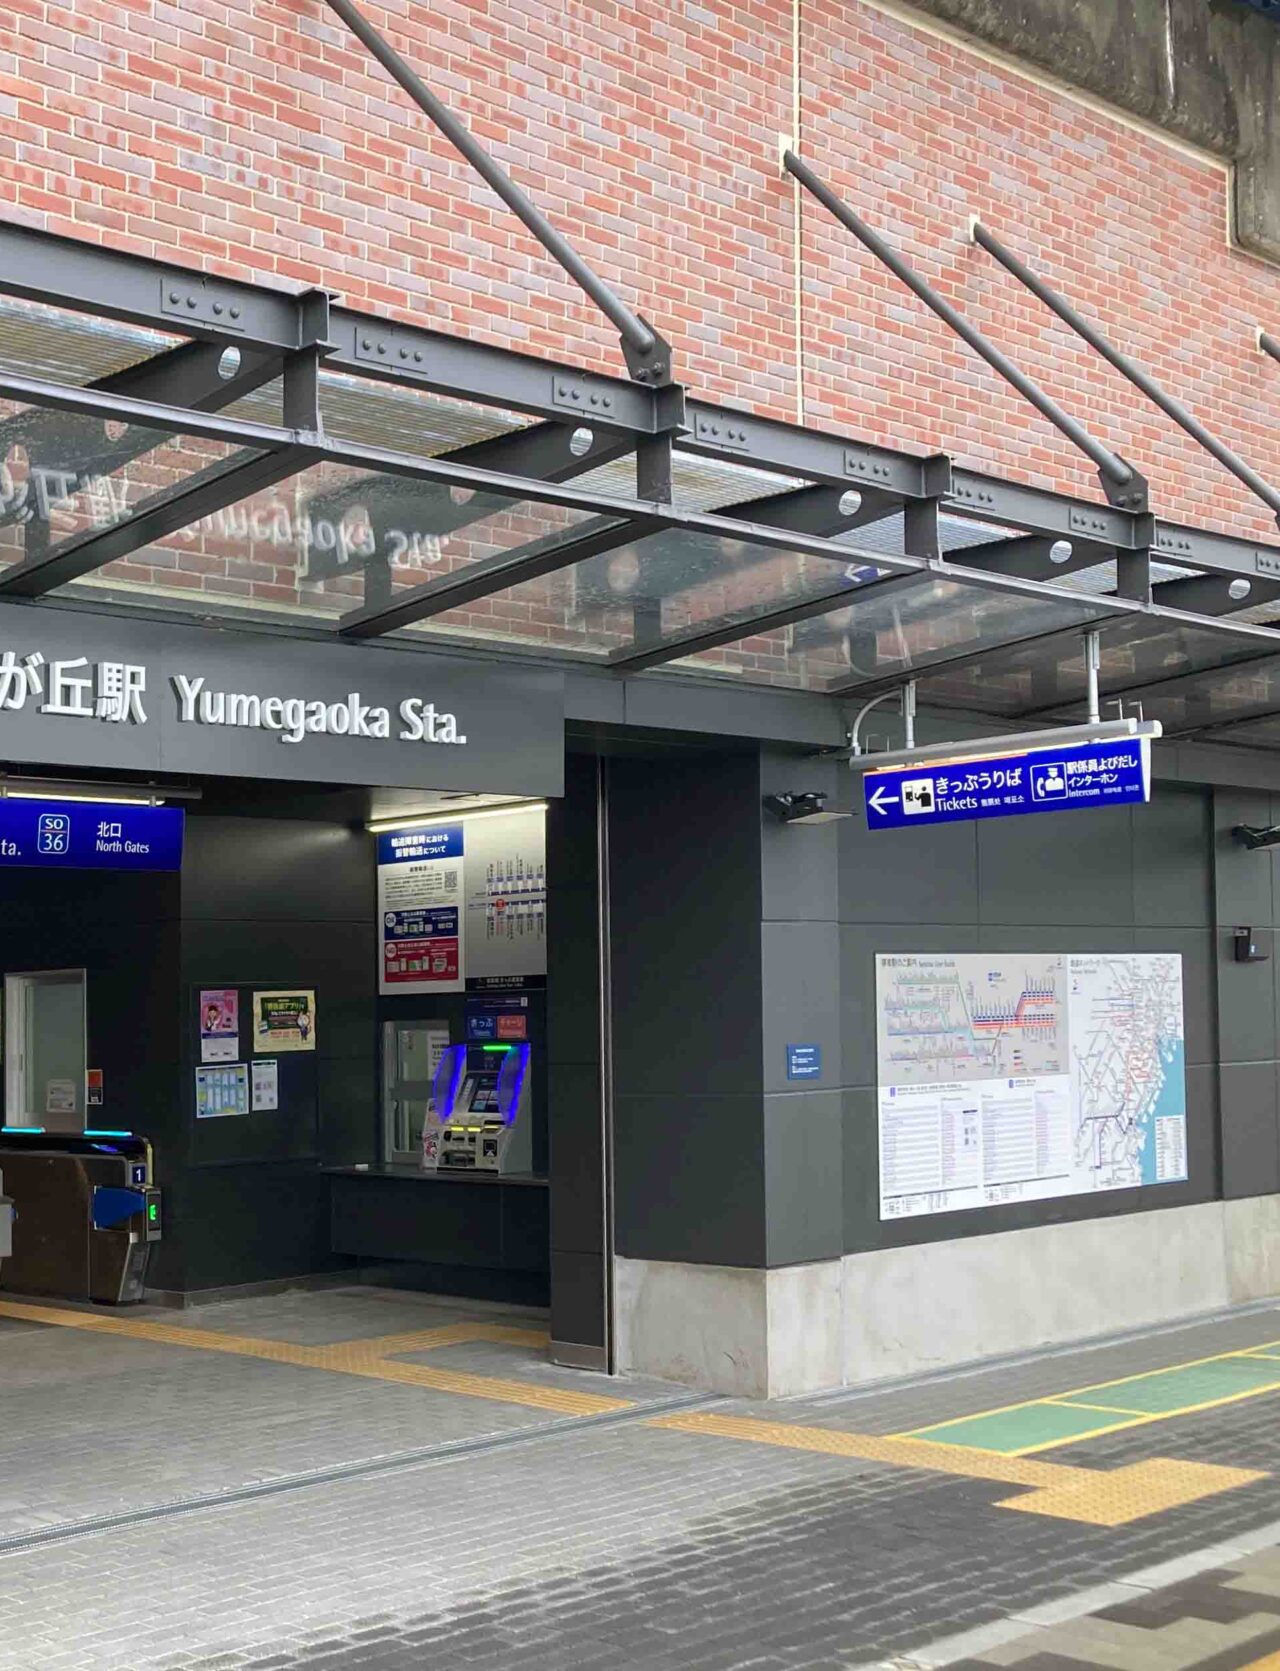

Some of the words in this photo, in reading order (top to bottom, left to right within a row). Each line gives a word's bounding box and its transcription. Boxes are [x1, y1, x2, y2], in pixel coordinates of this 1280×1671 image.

[172, 675, 390, 743] Yumegaoka
[400, 698, 467, 744] Sta.
[1067, 755, 1138, 775] 駅係員よびだし
[935, 767, 1023, 795] きっぷうりば
[1068, 773, 1118, 788] インターホン
[1068, 788, 1100, 798] Intercom
[935, 797, 978, 812] Tickets
[45, 818, 64, 830] SO
[96, 821, 122, 838] 北口
[43, 833, 64, 851] 36
[96, 839, 122, 852] North
[124, 840, 150, 853] Gates
[135, 1168, 141, 1182] 1
